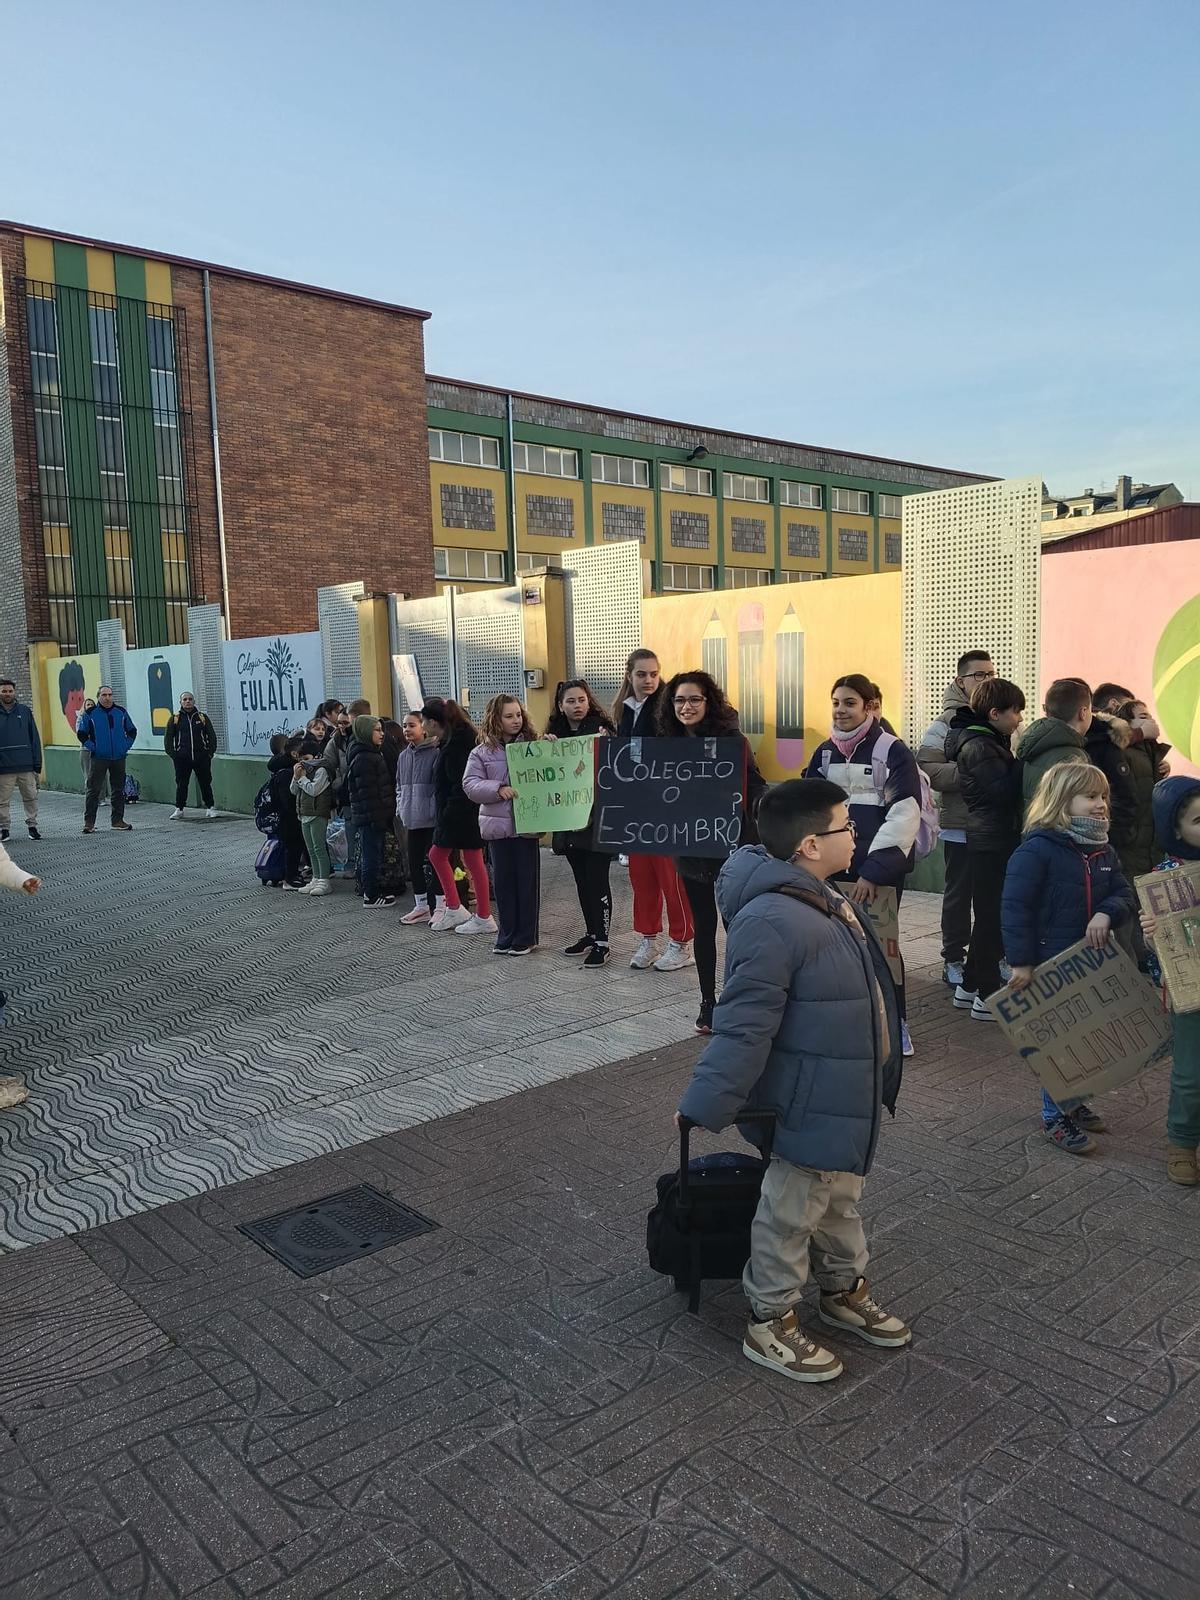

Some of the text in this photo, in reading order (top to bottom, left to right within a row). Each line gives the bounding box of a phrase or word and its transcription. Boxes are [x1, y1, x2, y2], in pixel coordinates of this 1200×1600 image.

[237, 652, 263, 676] Colegio
[516, 767, 565, 784] MENOS
[662, 786, 680, 803] O
[1024, 974, 1129, 1047] BAJO LA
[769, 1343, 783, 1358] FILA
